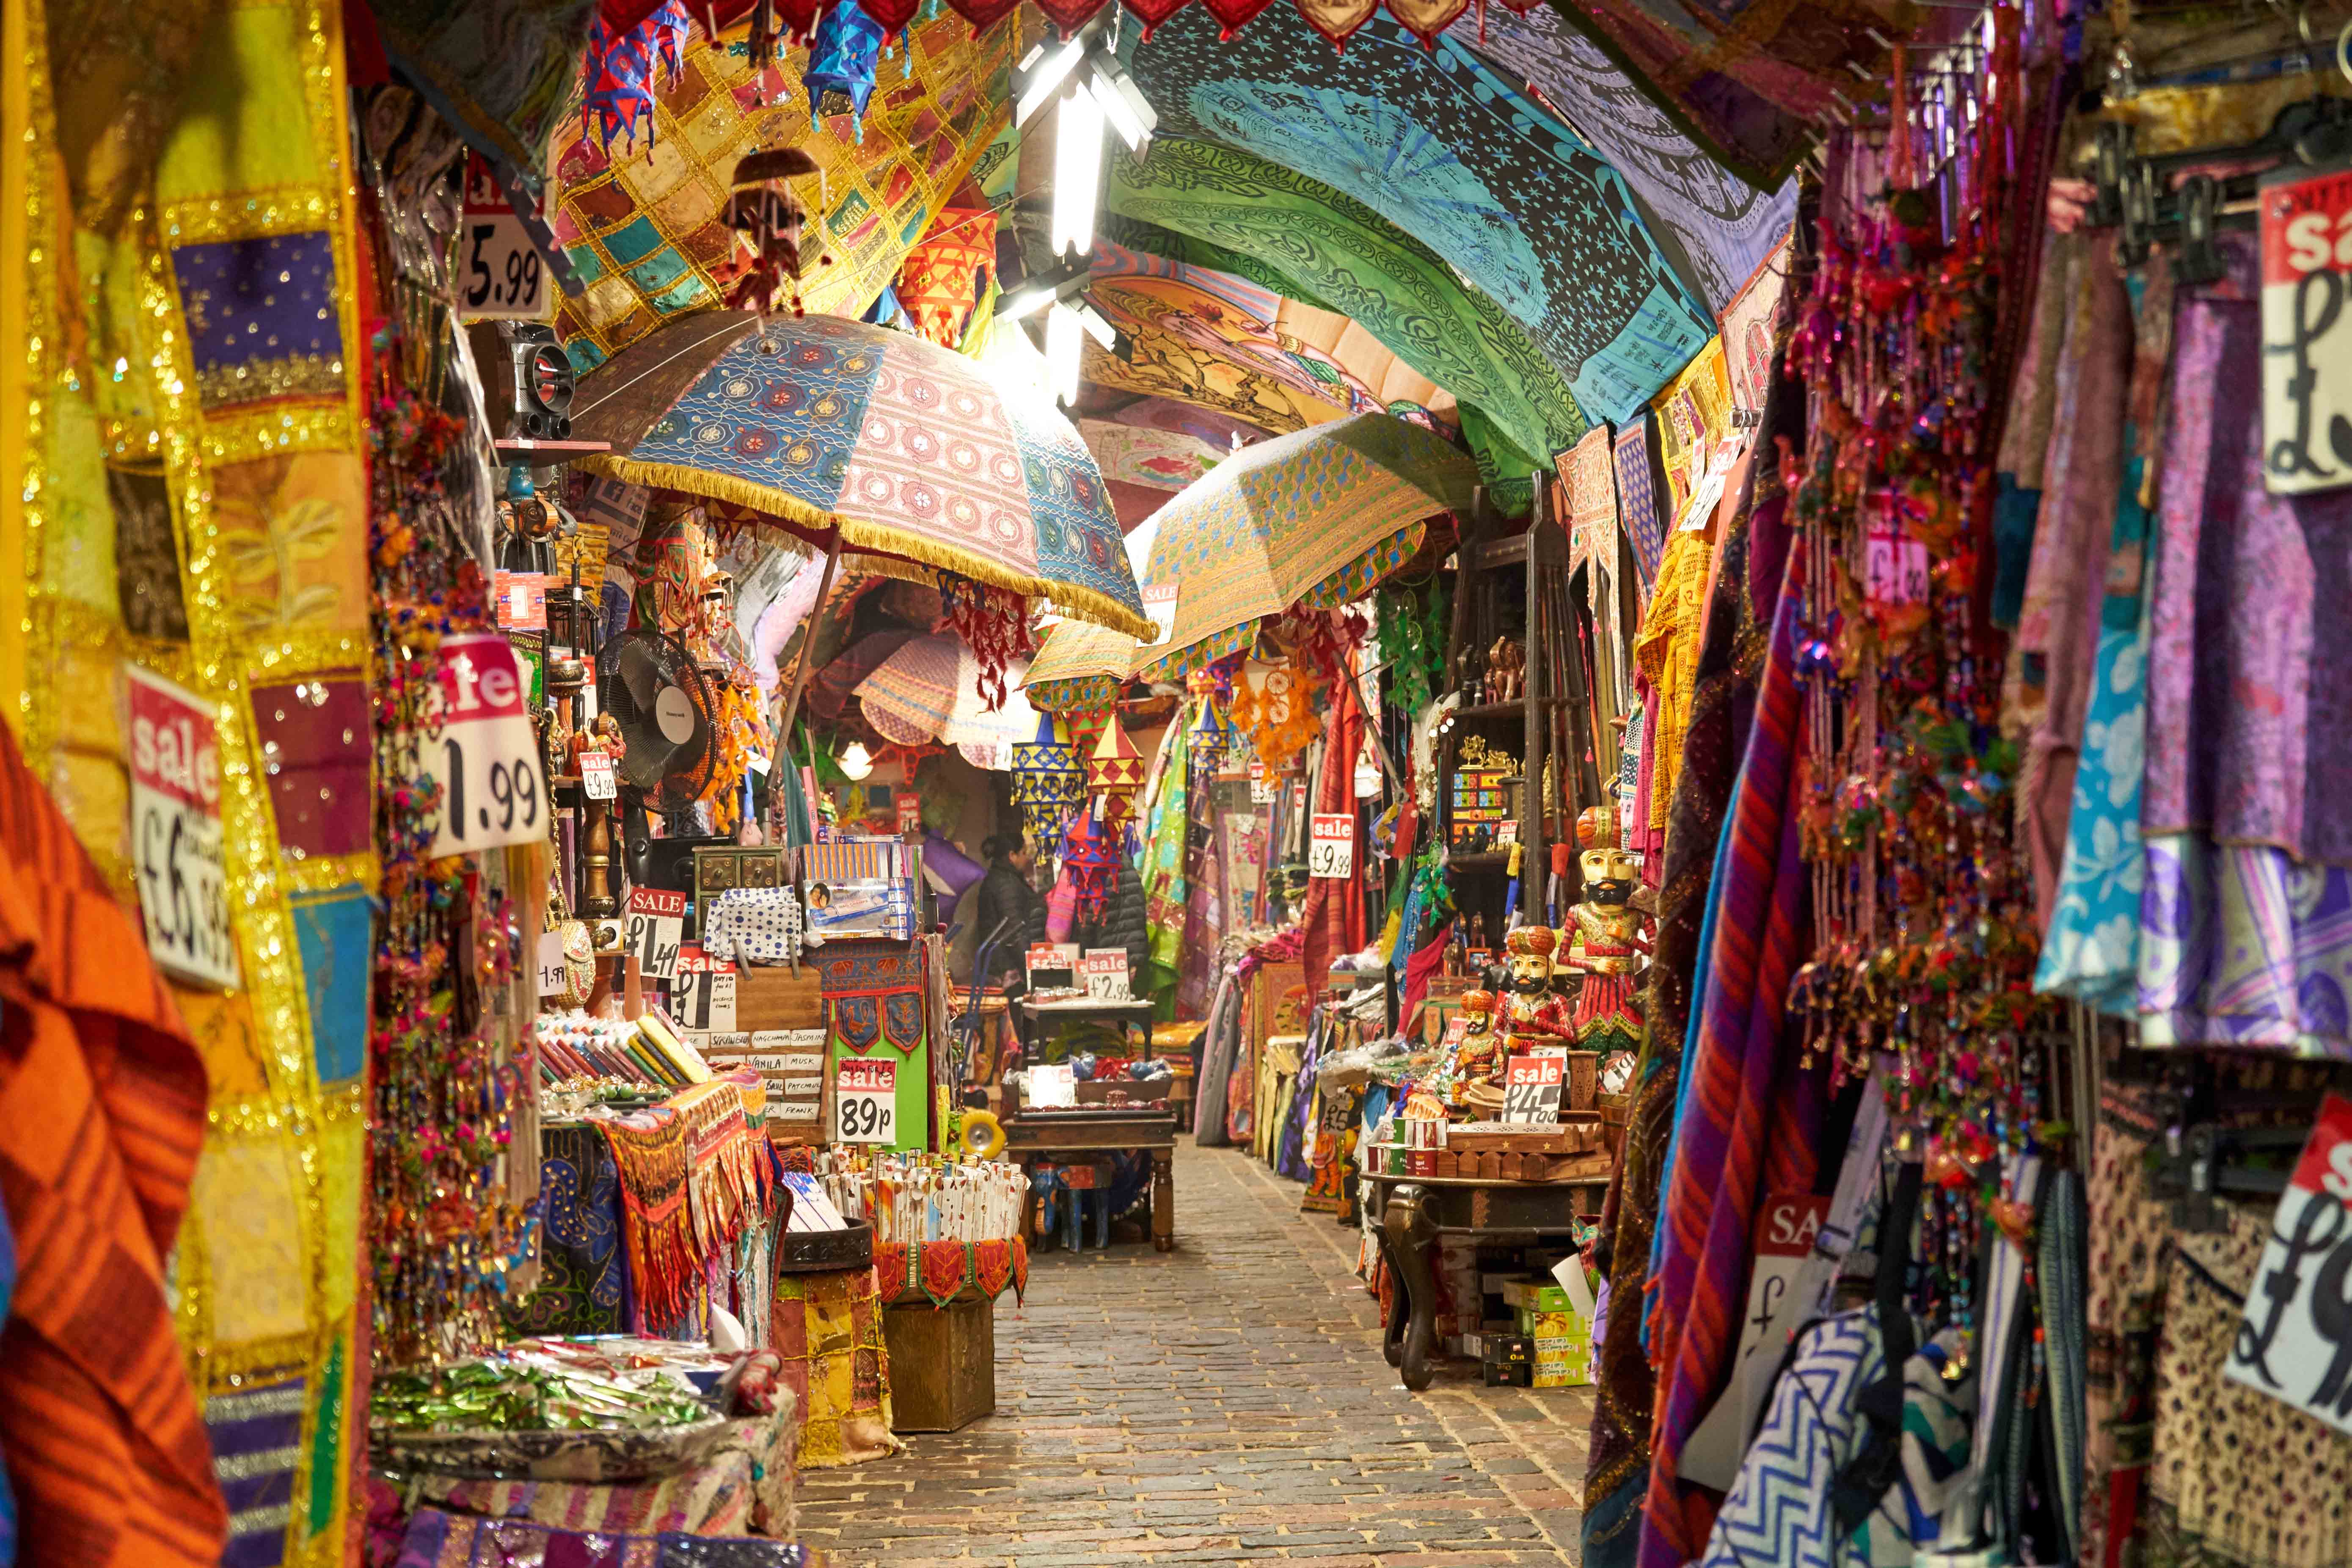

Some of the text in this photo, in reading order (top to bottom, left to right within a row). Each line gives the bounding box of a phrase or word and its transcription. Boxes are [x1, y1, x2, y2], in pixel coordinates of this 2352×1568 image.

[1146, 586, 1176, 601] SALE
[582, 756, 610, 769] sale
[587, 772, 614, 796] £9.99
[1314, 819, 1351, 838] sale
[1311, 845, 1350, 874] £9.99
[633, 893, 680, 912] SALE
[677, 957, 728, 972] sale
[1089, 956, 1127, 971] sale
[1091, 976, 1129, 1000] £2.99
[672, 970, 713, 1029] £1
[838, 1066, 893, 1088] sale
[1514, 1061, 1558, 1083] sale
[841, 1097, 890, 1136] 89p
[1769, 1205, 1819, 1244] SA
